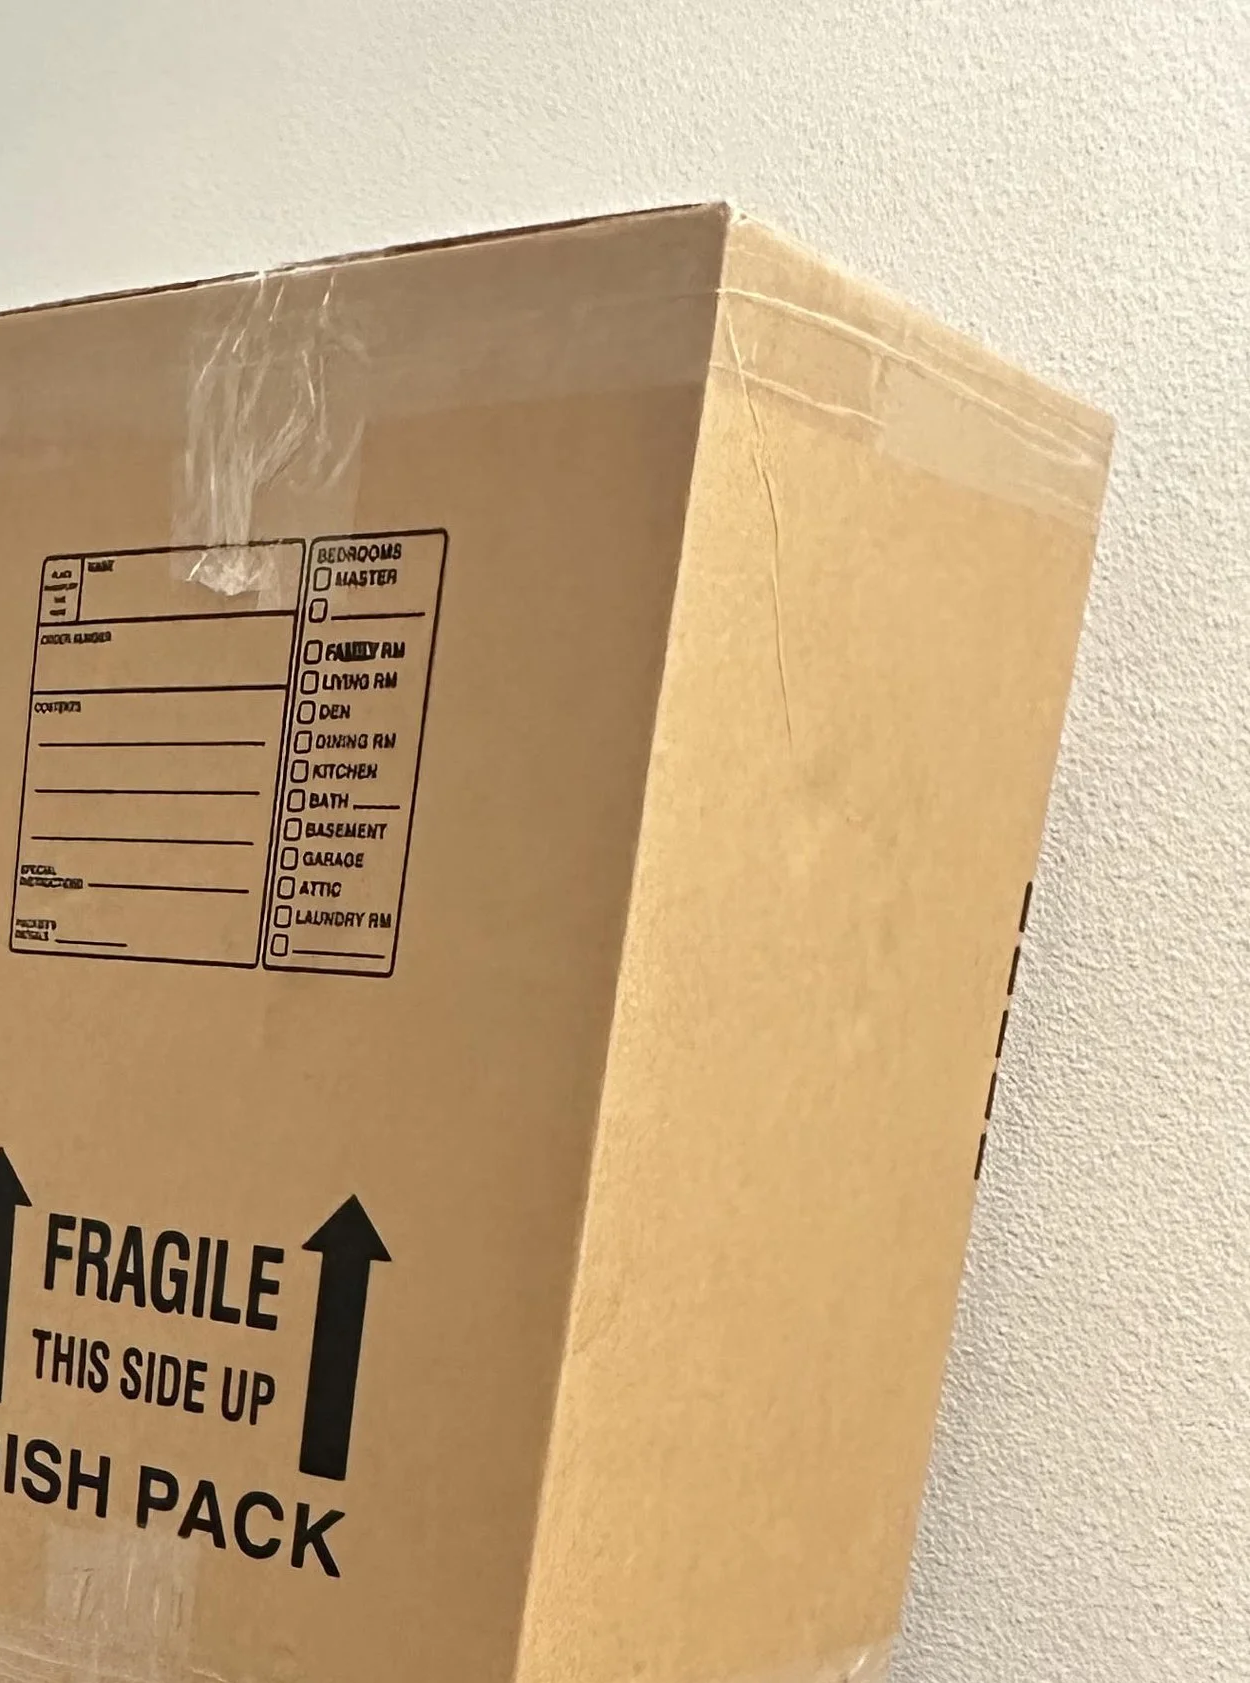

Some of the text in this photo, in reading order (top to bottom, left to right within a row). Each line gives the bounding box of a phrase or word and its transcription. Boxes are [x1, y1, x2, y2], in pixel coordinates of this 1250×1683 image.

[317, 543, 402, 564] BEDROOMS
[335, 568, 398, 587] MASTER
[380, 641, 406, 659] RM
[322, 671, 398, 690] LIVING RM
[319, 704, 351, 720] DEN
[315, 733, 397, 750] DINING RM
[312, 763, 378, 779] KITCHEN
[309, 793, 349, 809] BATH
[305, 822, 388, 839] BASEMENT
[302, 852, 365, 868] GARAGE
[299, 881, 342, 898] ATTIC
[295, 910, 392, 929] LAUNDRY RM
[44, 1212, 285, 1332] FRAGILE
[32, 1327, 276, 1426] THIS SIDE UP
[135, 1465, 347, 1578] PACK
